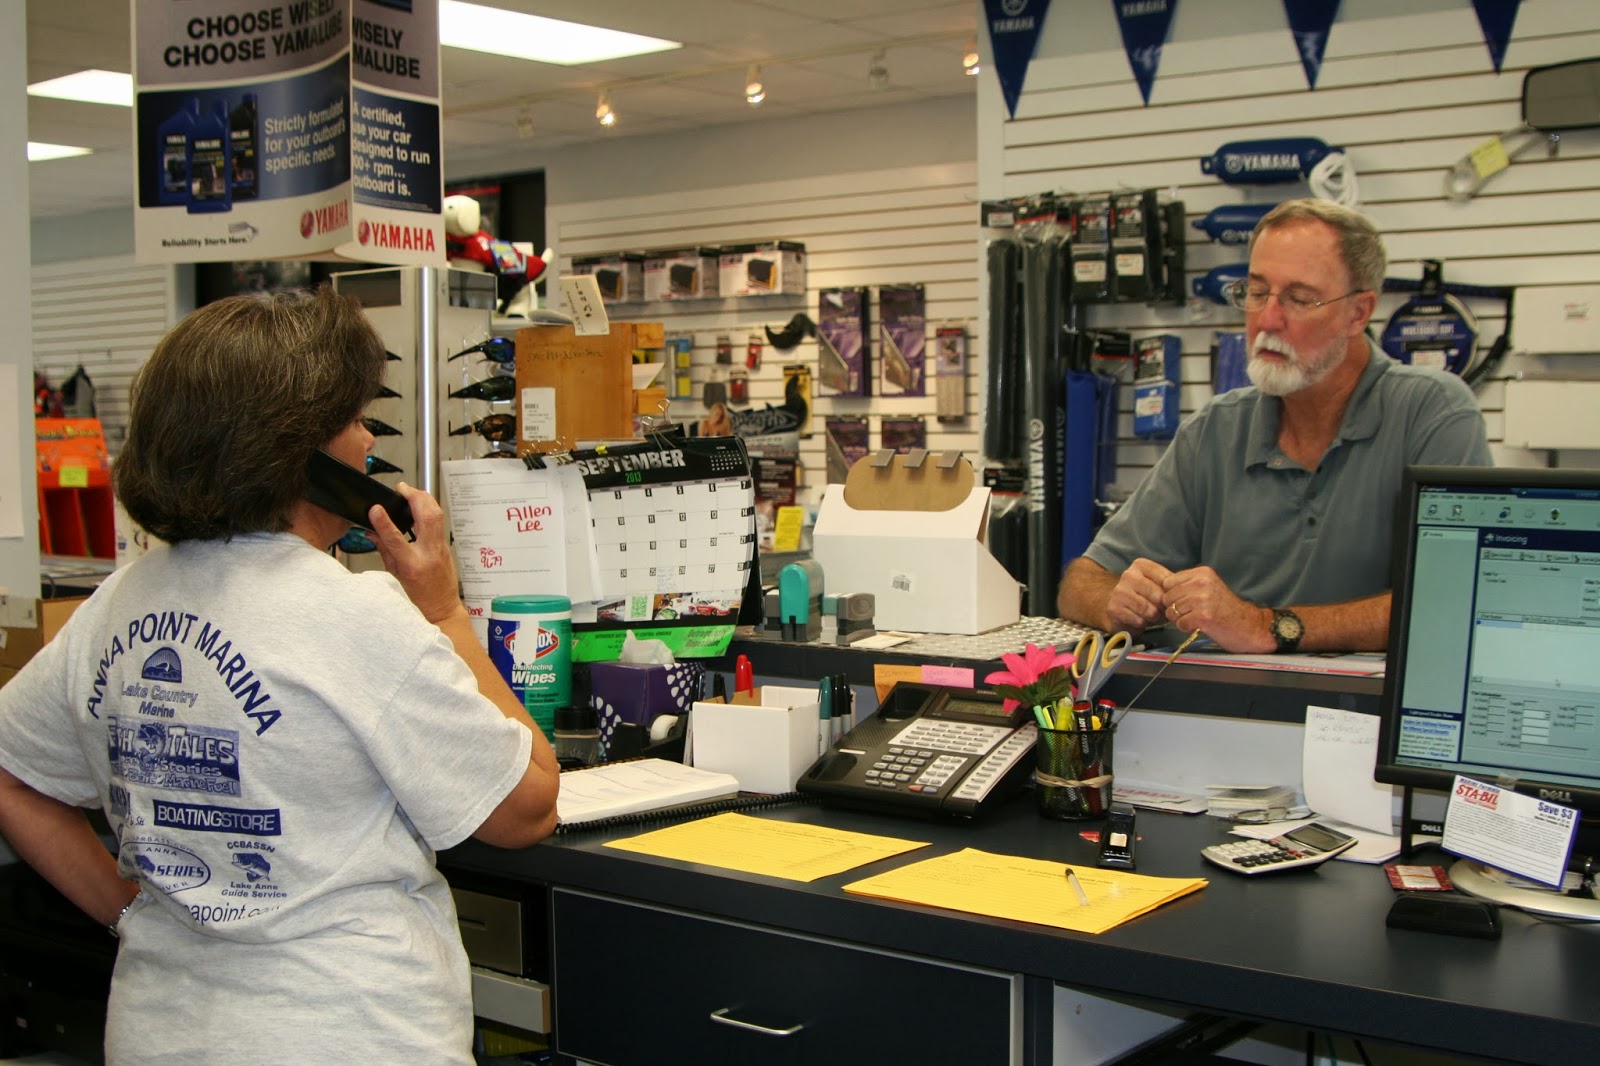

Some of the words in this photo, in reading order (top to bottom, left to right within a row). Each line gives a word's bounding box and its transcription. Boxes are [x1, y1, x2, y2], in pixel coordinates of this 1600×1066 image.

[187, 12, 283, 40] CHOOSE
[163, 38, 266, 68] CHOOSE
[272, 9, 343, 57] YAMALUBE
[352, 42, 421, 79] MALUBE
[265, 113, 306, 136] Strictly
[361, 105, 406, 128] certified,
[265, 138, 282, 153] for
[286, 134, 311, 155] your
[368, 125, 390, 141] your
[392, 130, 411, 145] car
[265, 150, 311, 175] specific
[396, 145, 408, 161] to
[411, 151, 430, 165] run
[1243, 153, 1300, 171] YAMAHA
[315, 199, 349, 236] YAMAHA
[372, 220, 436, 253] YAMAHA
[577, 449, 686, 477] SEPTEMBER
[625, 471, 642, 483] 2013
[506, 505, 552, 521] Allen
[517, 520, 544, 533] Lee
[1496, 534, 1528, 545] Invoicing
[128, 611, 199, 650] POINT
[194, 621, 282, 737] MARINA
[512, 671, 556, 687] Wipes
[121, 681, 149, 699] Lake
[151, 685, 199, 708] Country
[138, 701, 175, 718] Marine
[167, 726, 236, 765] TALES
[1456, 784, 1499, 805] STA-BIL
[1540, 789, 1572, 802] DELL
[1538, 802, 1559, 816] Save
[1421, 824, 1442, 833] DELL
[146, 847, 177, 856] ANNA
[156, 865, 204, 878] SERIES
[163, 881, 188, 891] IVER
[221, 889, 248, 898] Guide
[251, 890, 287, 898] Service
[231, 881, 251, 890] Lake
[184, 902, 279, 926] apoint.com
